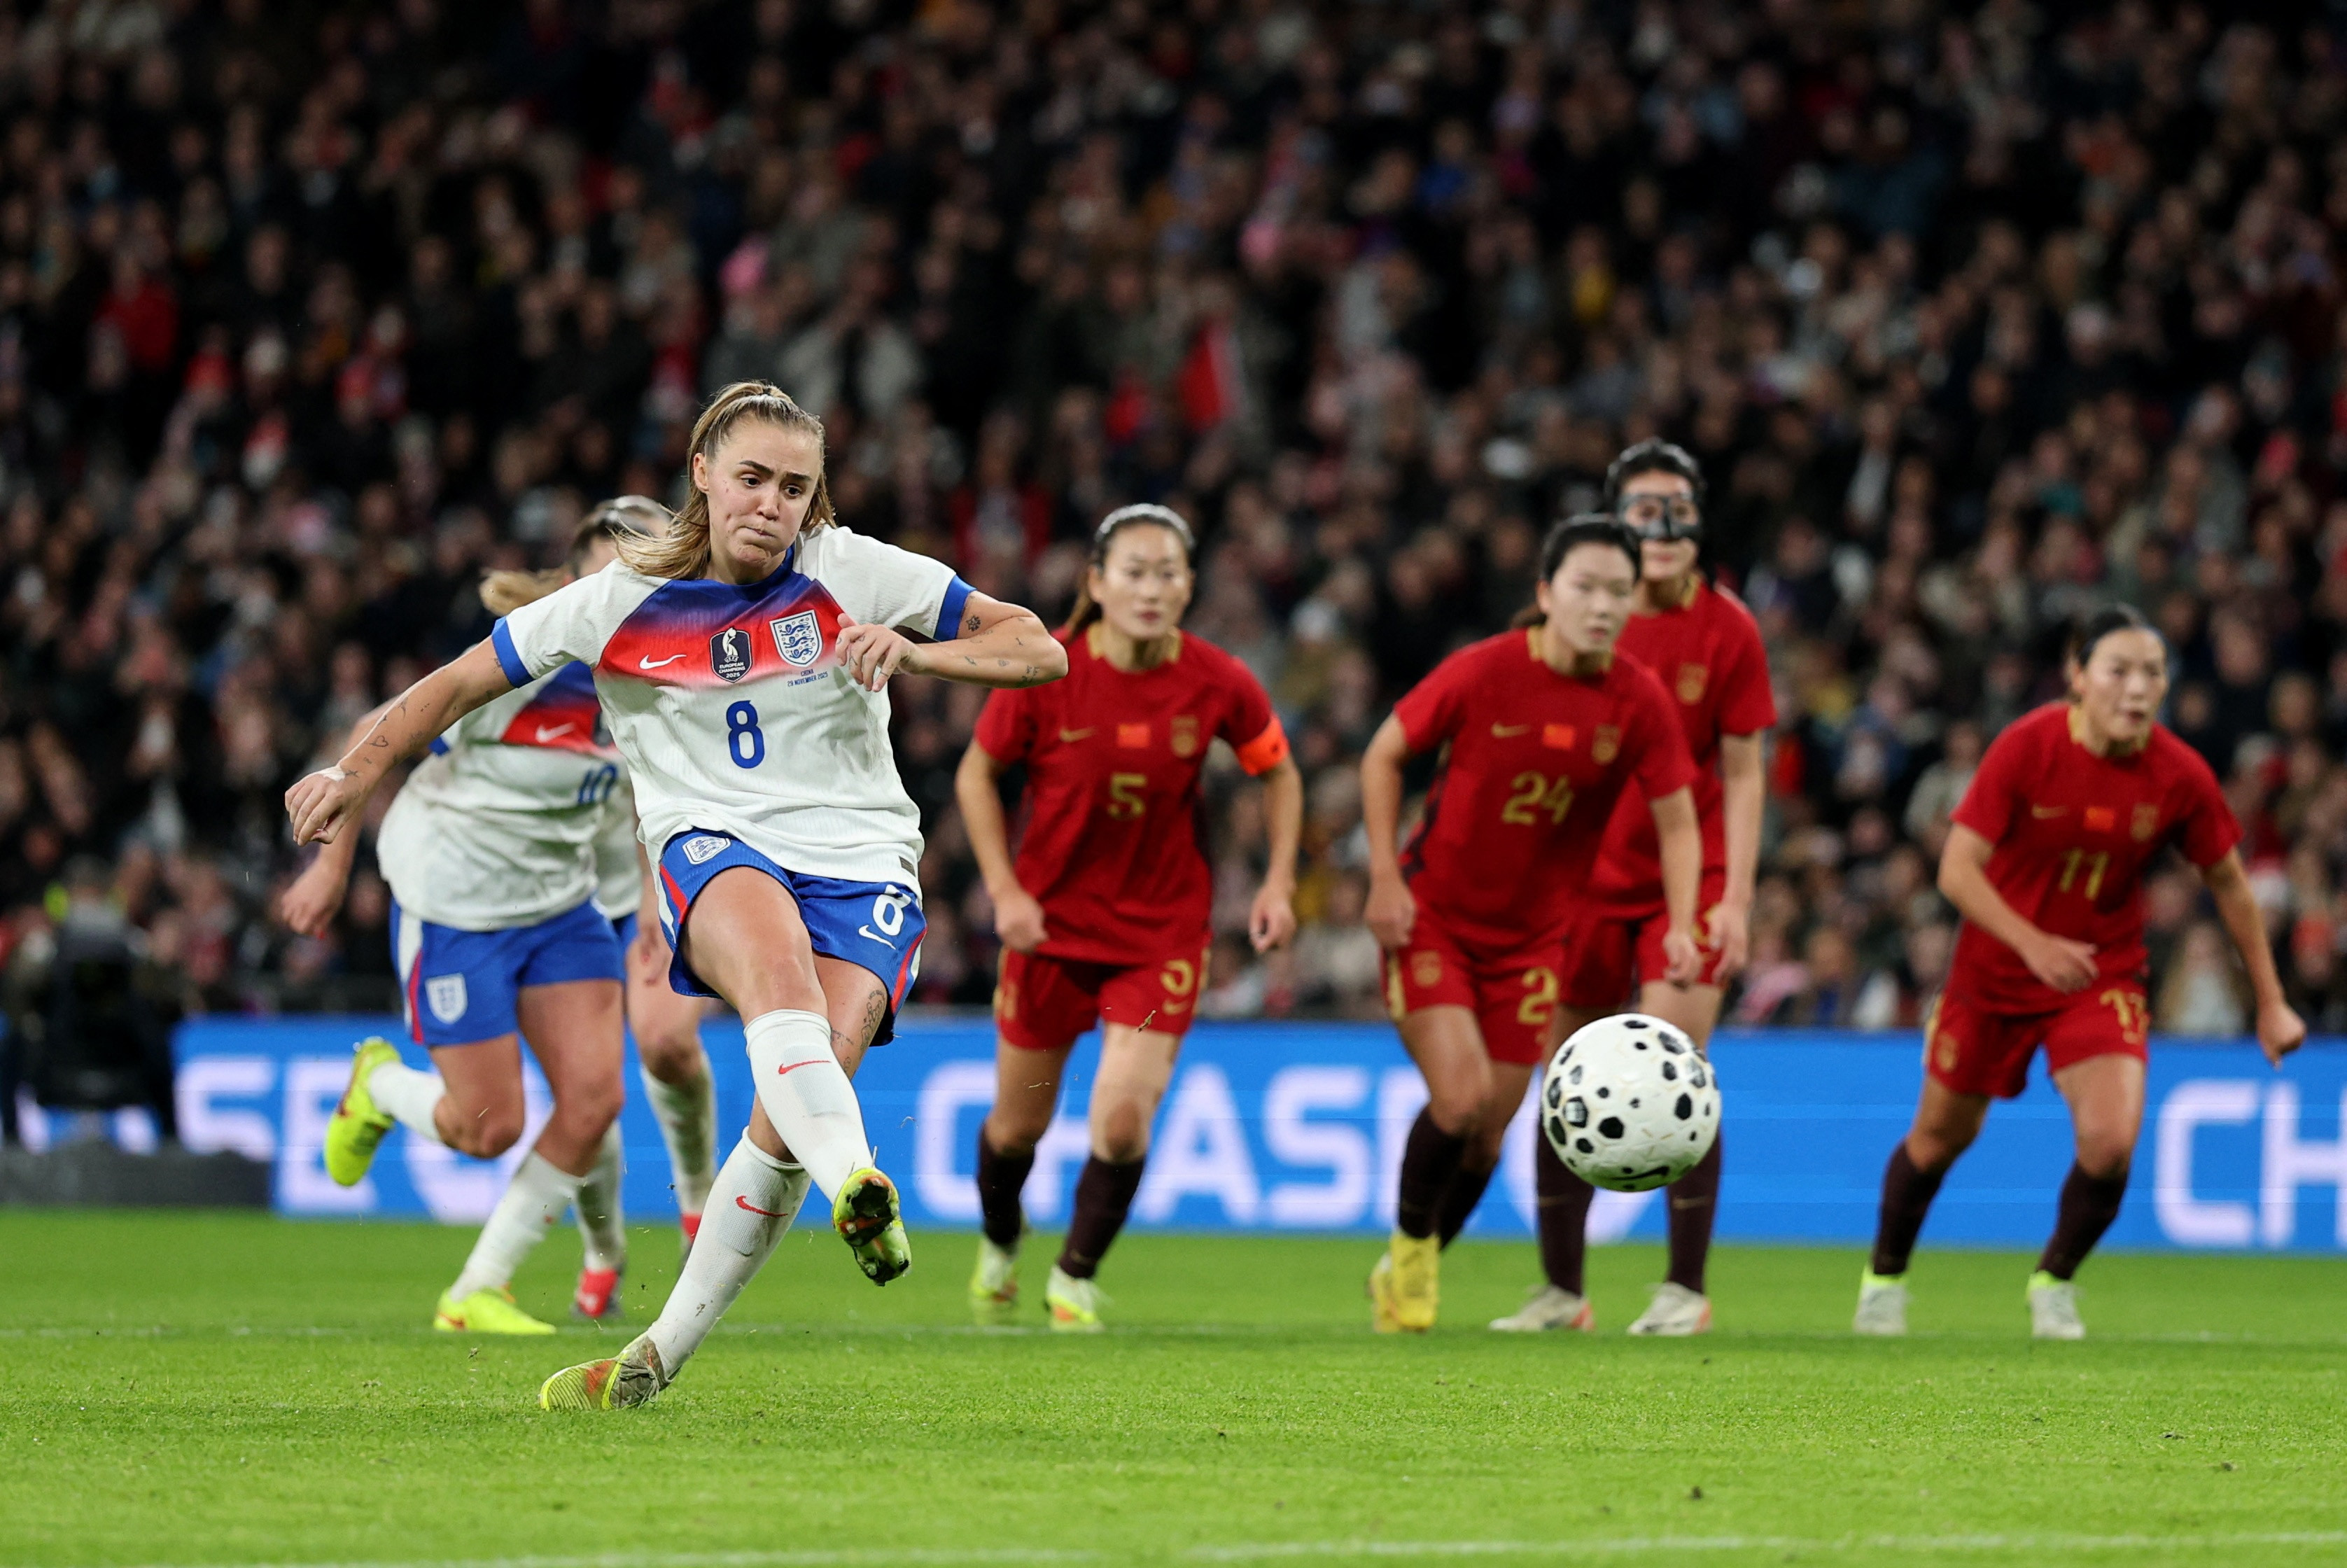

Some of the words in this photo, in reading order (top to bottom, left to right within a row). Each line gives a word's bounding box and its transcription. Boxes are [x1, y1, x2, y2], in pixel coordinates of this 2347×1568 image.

[718, 666, 746, 674] CHAMPIONS
[794, 675, 817, 685] NOVEMBER
[726, 700, 765, 769] 8
[1108, 774, 1147, 820] 5
[1501, 771, 1575, 826] 24
[2059, 847, 2108, 901] 11
